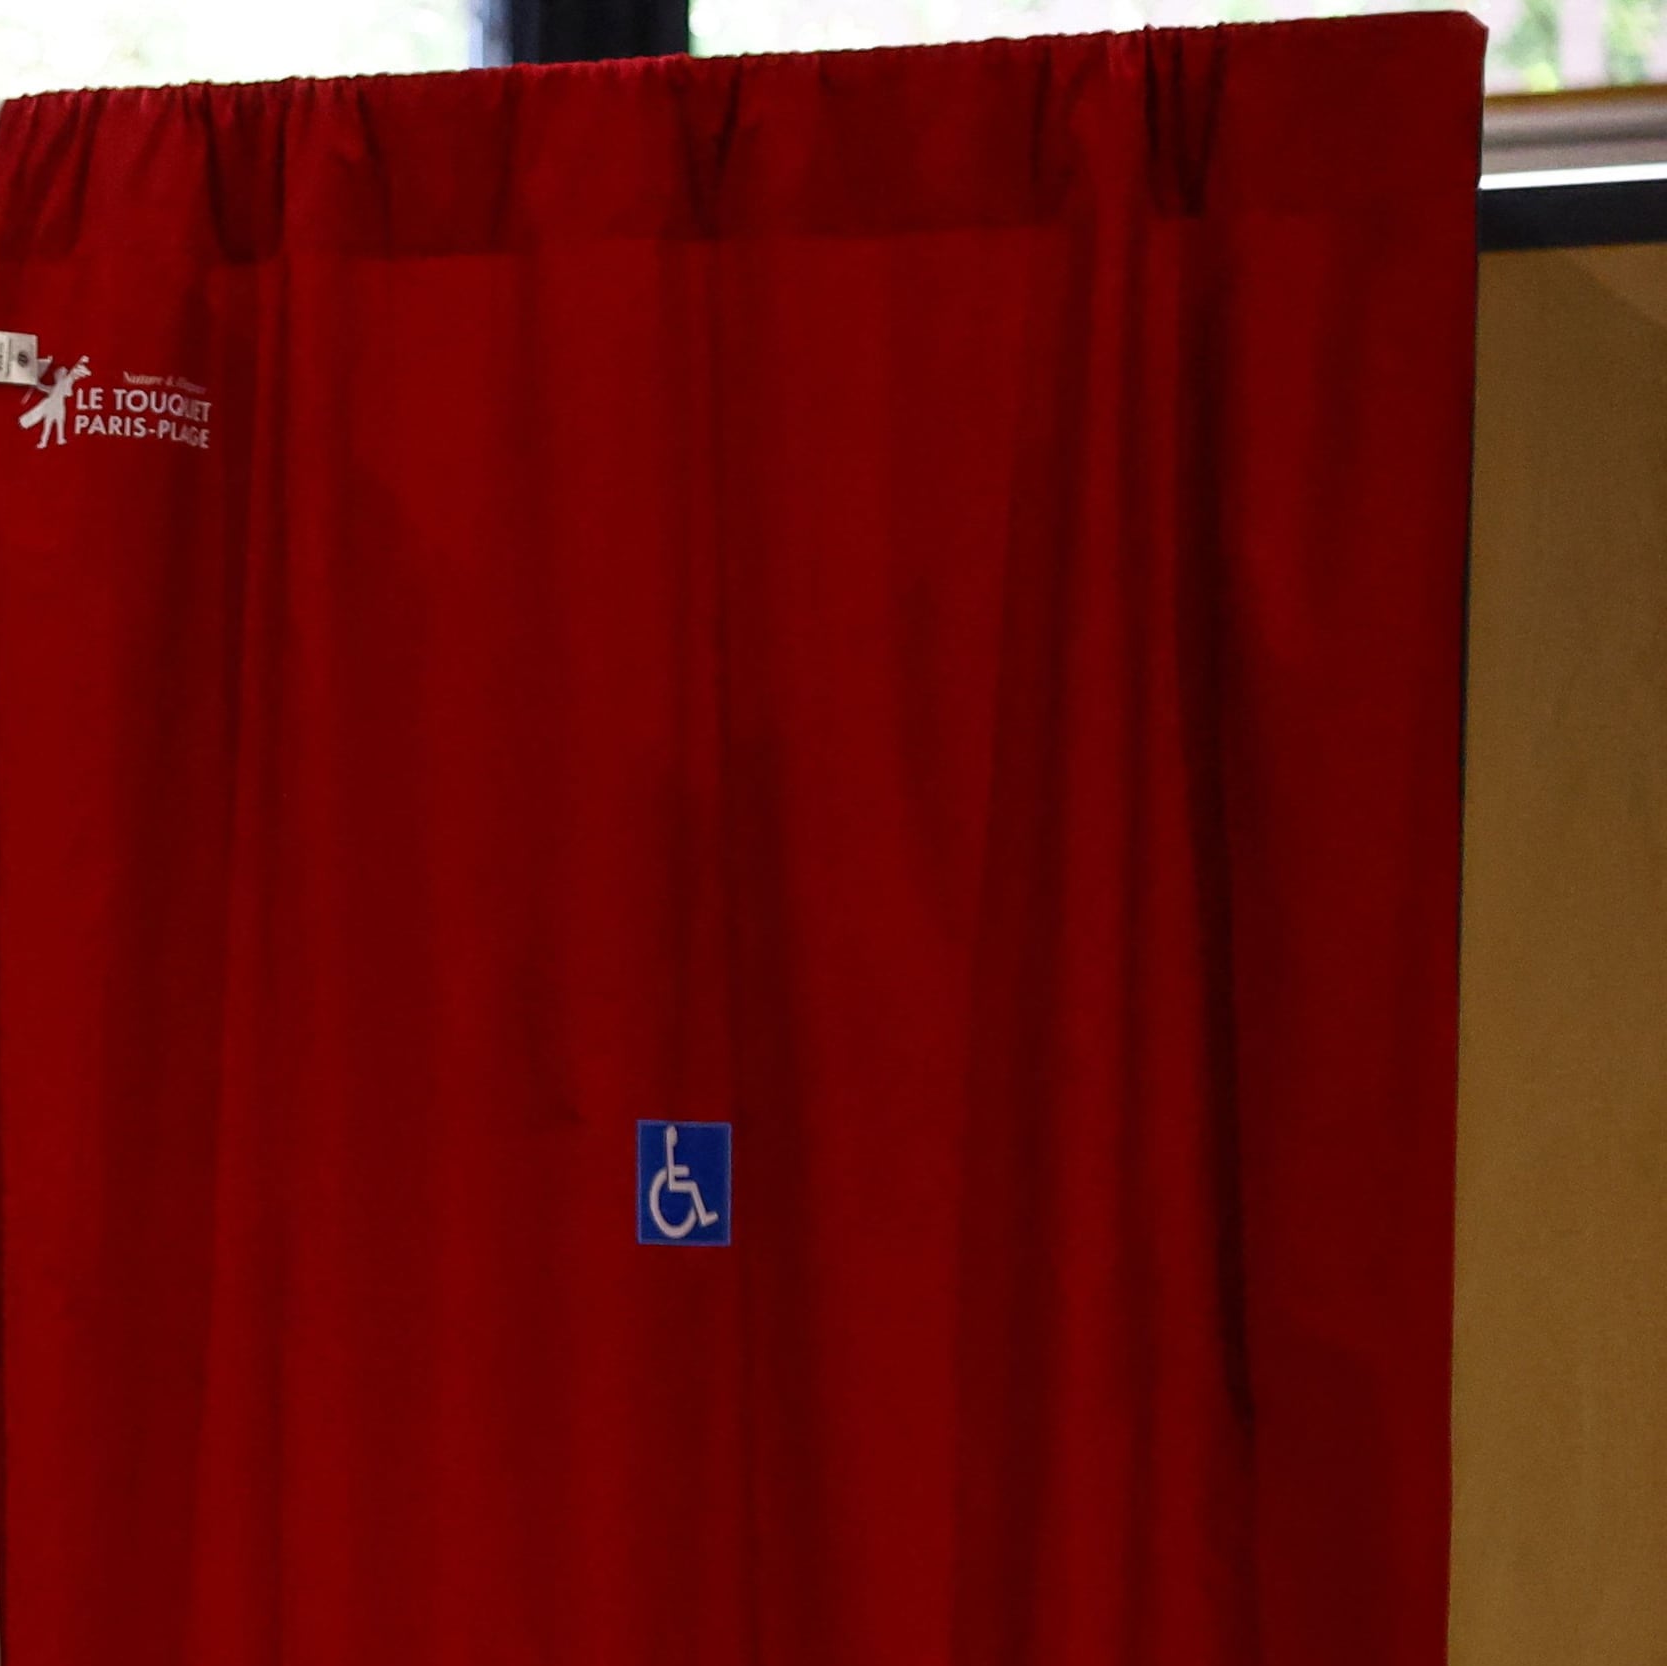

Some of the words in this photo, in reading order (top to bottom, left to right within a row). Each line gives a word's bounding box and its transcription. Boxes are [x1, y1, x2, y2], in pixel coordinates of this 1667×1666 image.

[76, 387, 104, 410] LE
[113, 388, 211, 422] TOUQUET
[74, 414, 209, 449] PARIS-PLAGE
